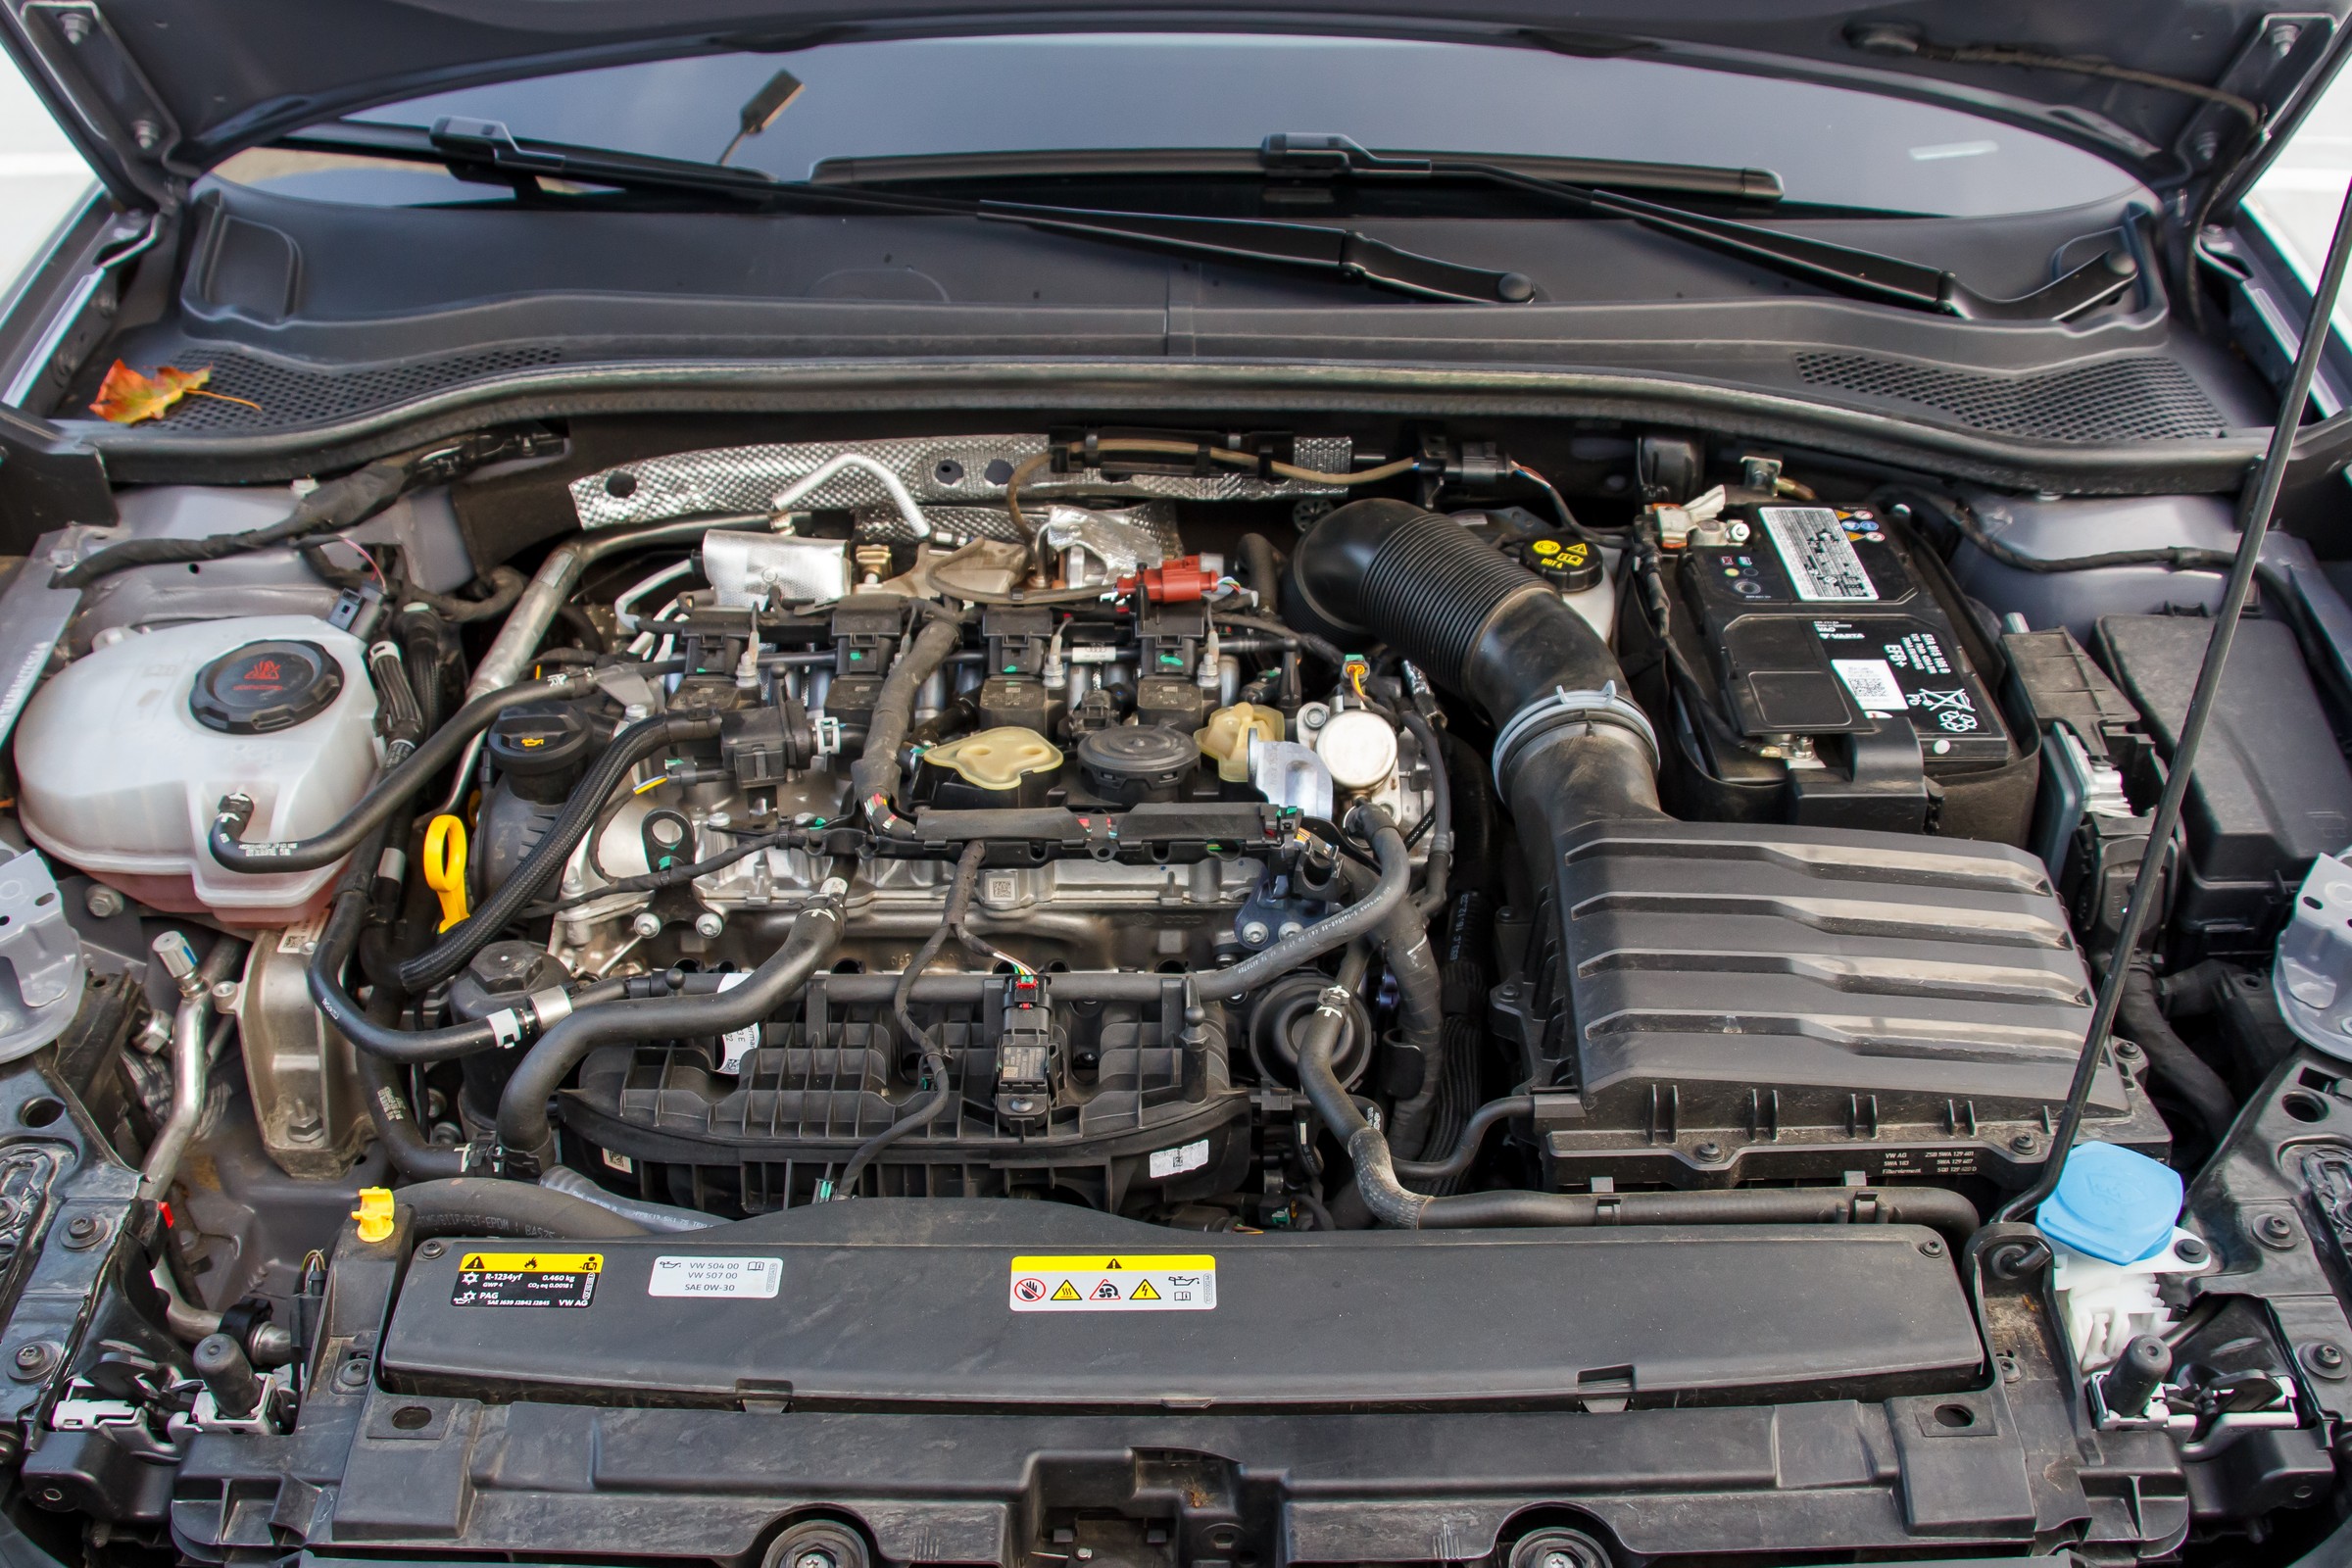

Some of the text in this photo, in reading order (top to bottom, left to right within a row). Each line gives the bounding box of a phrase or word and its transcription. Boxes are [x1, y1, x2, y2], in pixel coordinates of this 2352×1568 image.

[1541, 558, 1557, 566] DOT
[1884, 644, 1907, 667] EFB+
[1905, 694, 1921, 707] Pb
[484, 1273, 522, 1282] R-1234yf
[564, 1274, 575, 1283] kg
